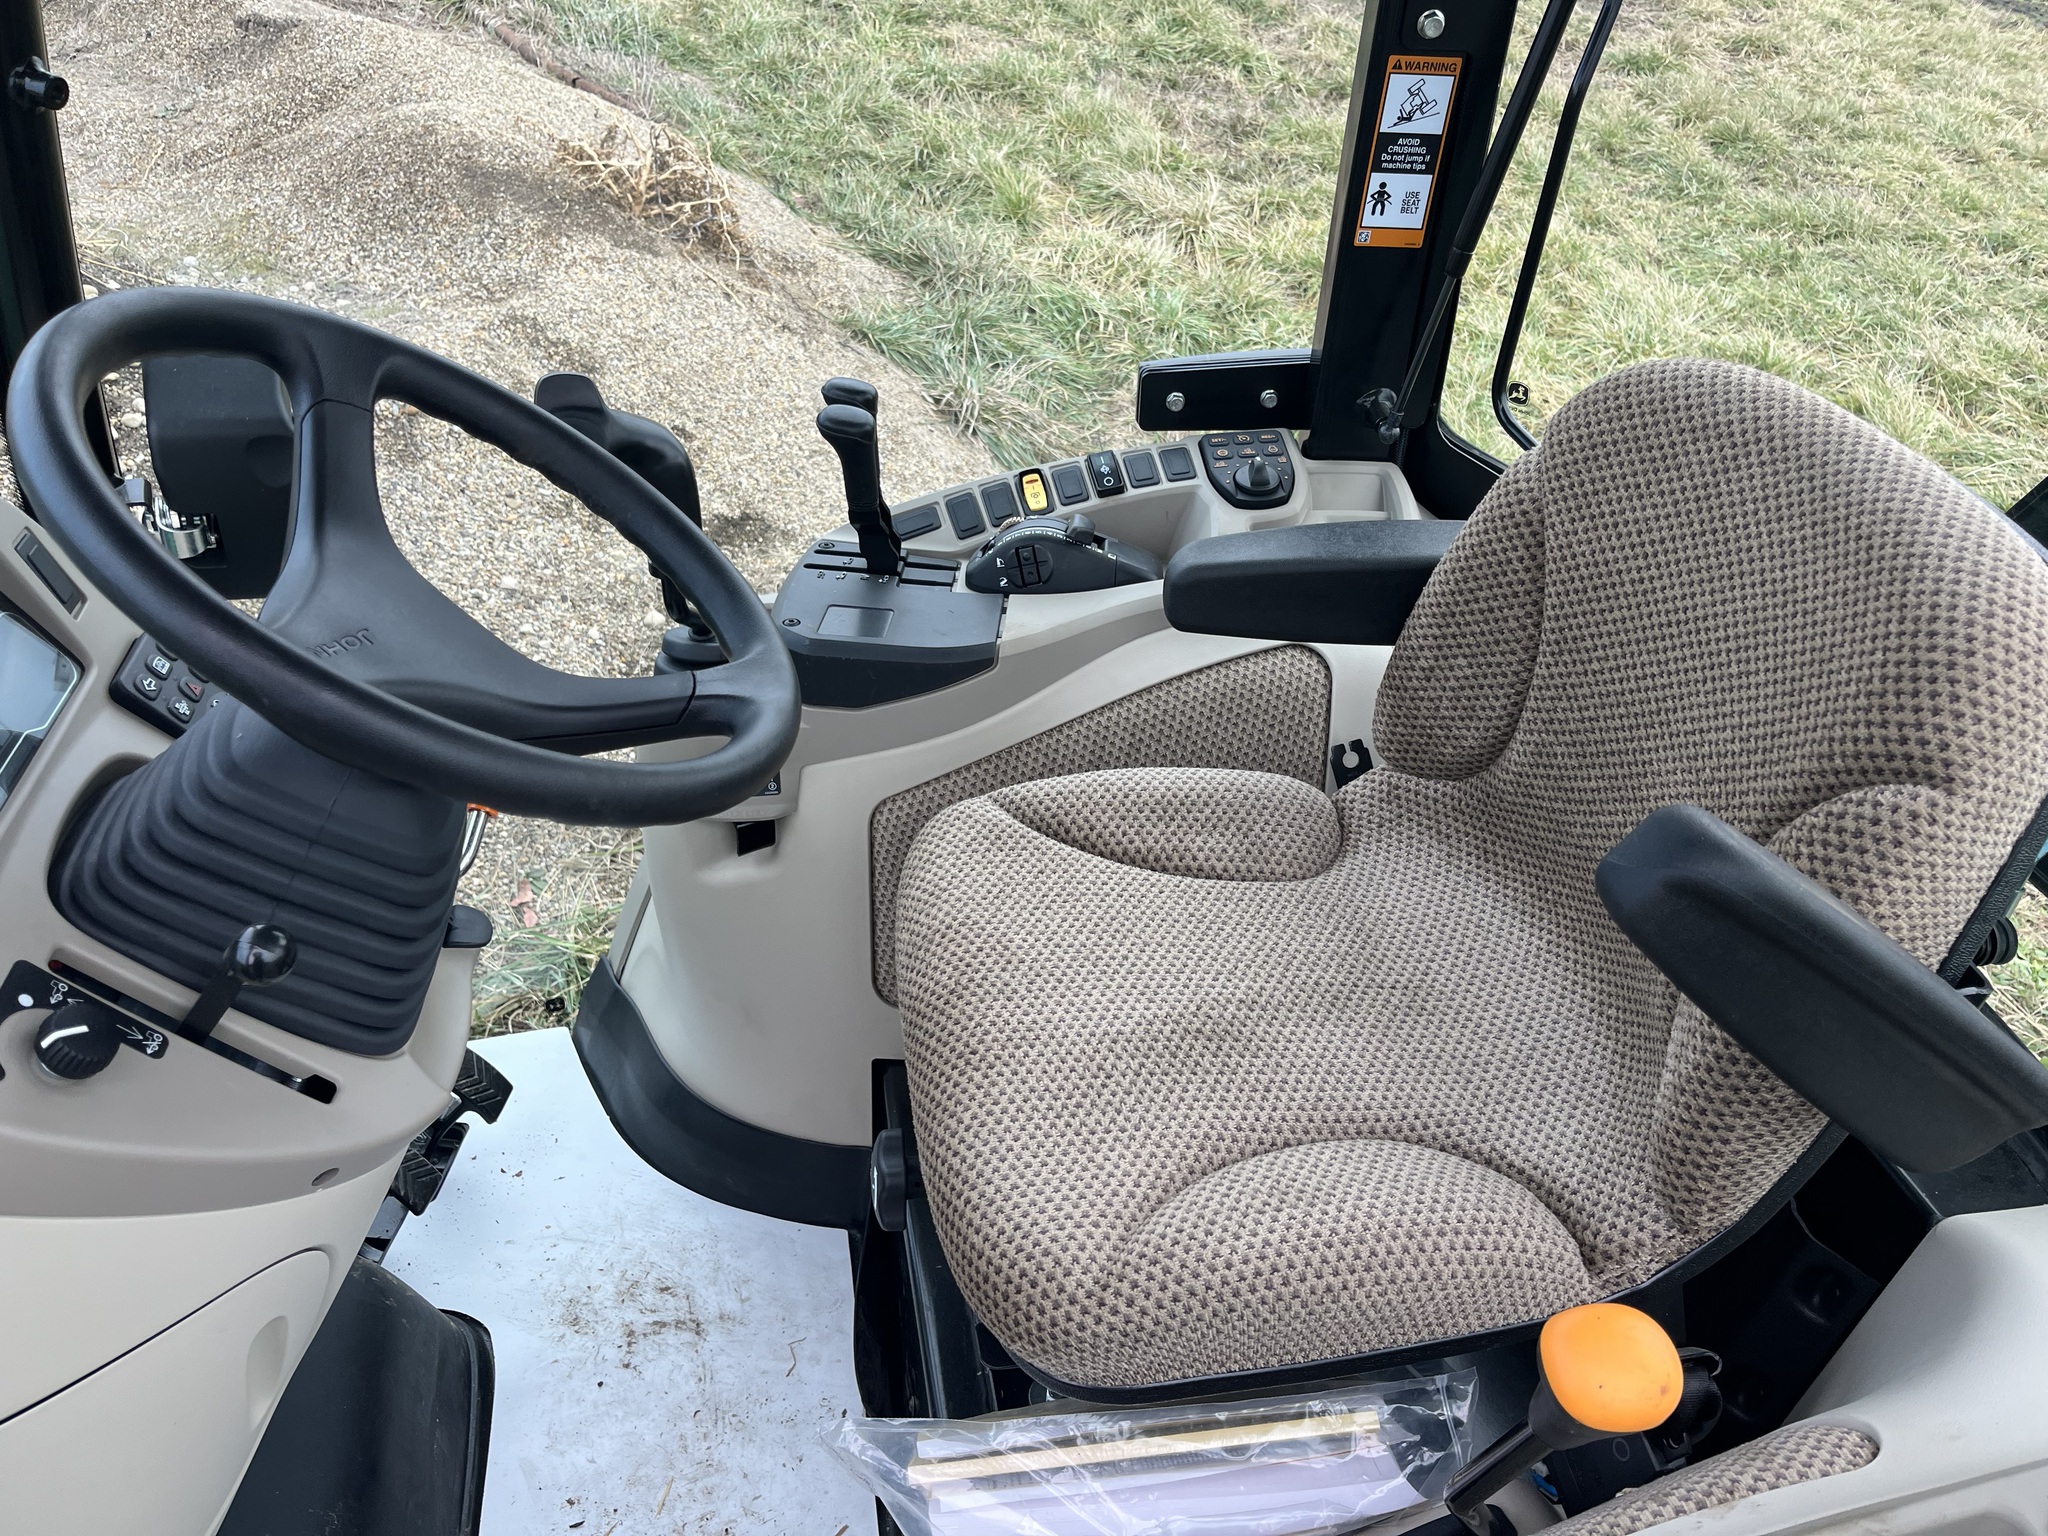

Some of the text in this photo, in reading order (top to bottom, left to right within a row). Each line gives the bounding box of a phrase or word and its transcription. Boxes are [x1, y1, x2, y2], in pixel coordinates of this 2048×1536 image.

[1404, 60, 1458, 73] WARNING
[1397, 137, 1421, 146] AVOID
[1387, 145, 1427, 154] CRUSHING
[1381, 153, 1431, 164] Do not jump if
[1381, 162, 1426, 171] machine tips
[1405, 191, 1421, 199] USE
[1401, 198, 1421, 207] SEAT
[1400, 206, 1419, 214] BELT
[306, 628, 374, 658] JOHN
